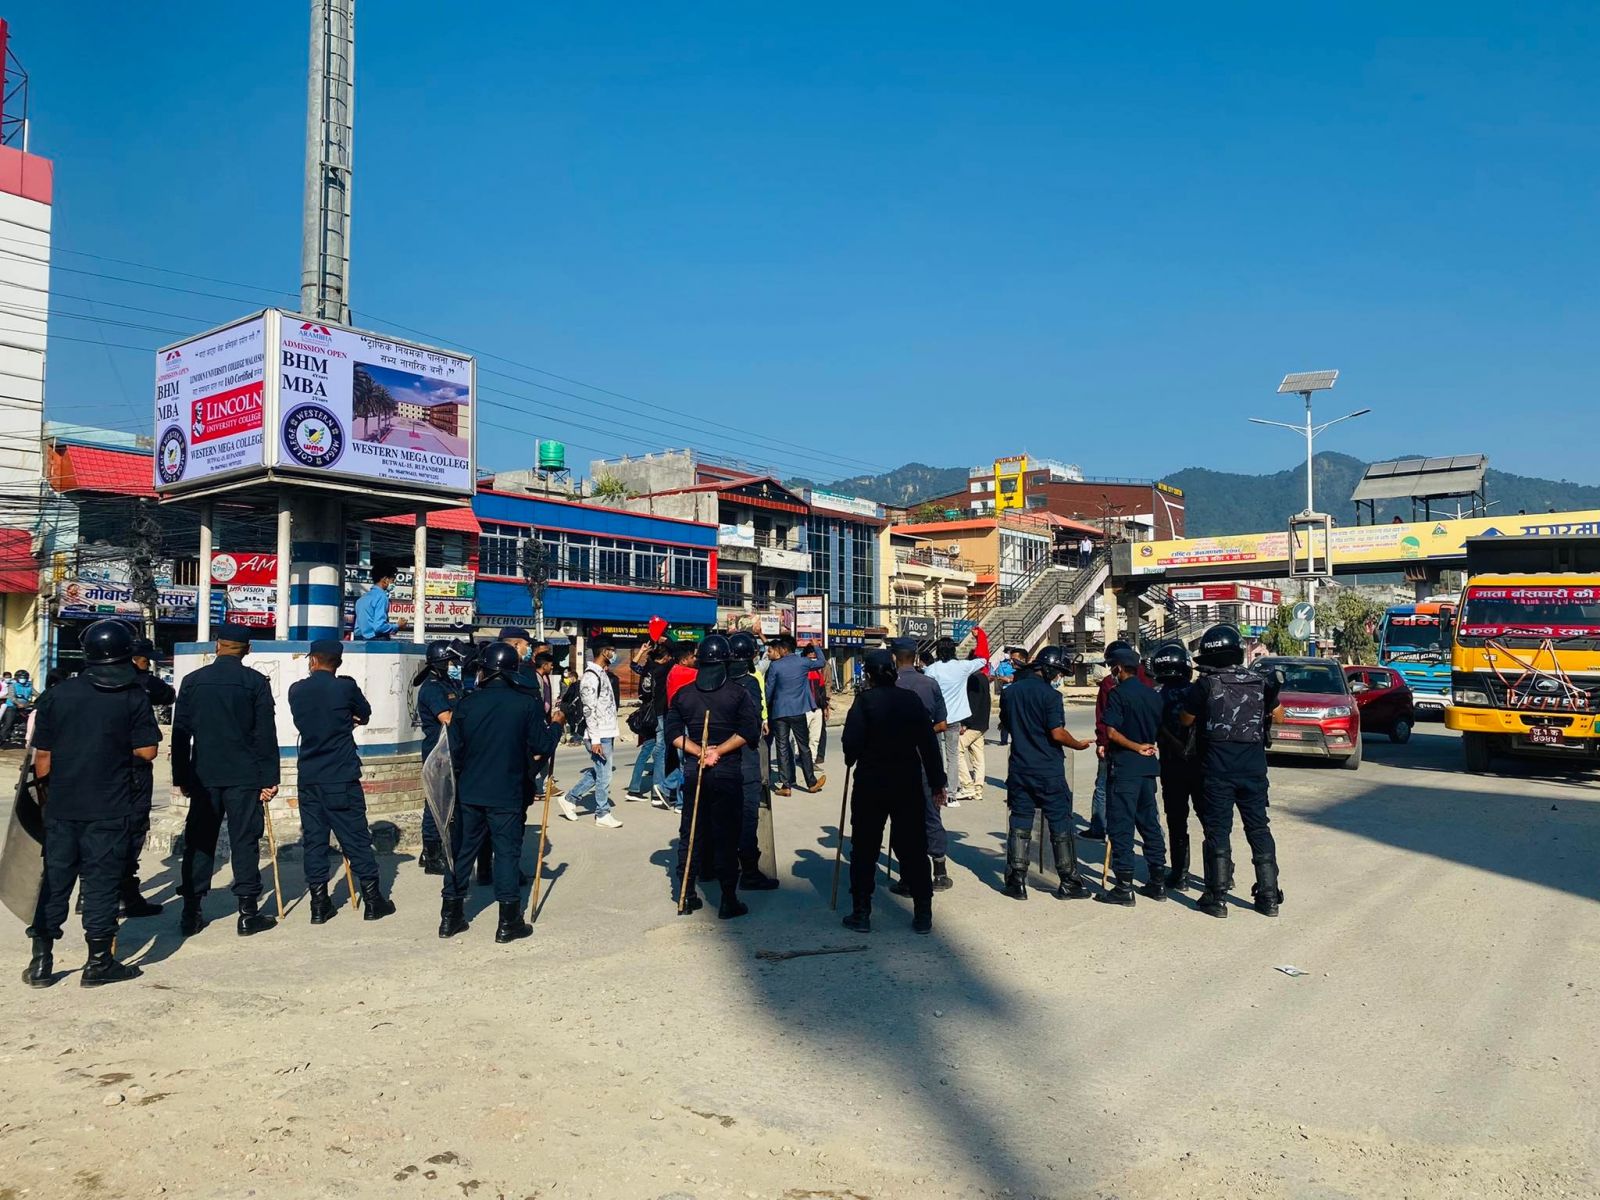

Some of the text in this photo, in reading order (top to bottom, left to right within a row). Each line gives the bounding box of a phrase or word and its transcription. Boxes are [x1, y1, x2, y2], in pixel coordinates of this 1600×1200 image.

[282, 340, 326, 355] ADMISSION
[327, 349, 348, 359] OPEN
[282, 350, 328, 374] BHM
[158, 380, 180, 400] BHM
[282, 374, 328, 397] MBA
[157, 403, 179, 421] MBA
[206, 391, 264, 421] LINCOLN
[206, 419, 237, 433] UNIVERSITY
[238, 413, 262, 424] COLLEGE
[191, 433, 264, 460] WESTERN MEGA COLLEGE
[288, 410, 340, 463] WESTERN MEGA COLLEGE
[352, 442, 399, 459] WESTERN
[401, 449, 428, 463] MEGA
[85, 586, 132, 603] मोबाई
[908, 620, 928, 631] Roca
[1204, 640, 1223, 649] POLICE
[1511, 696, 1585, 705] EICHER
